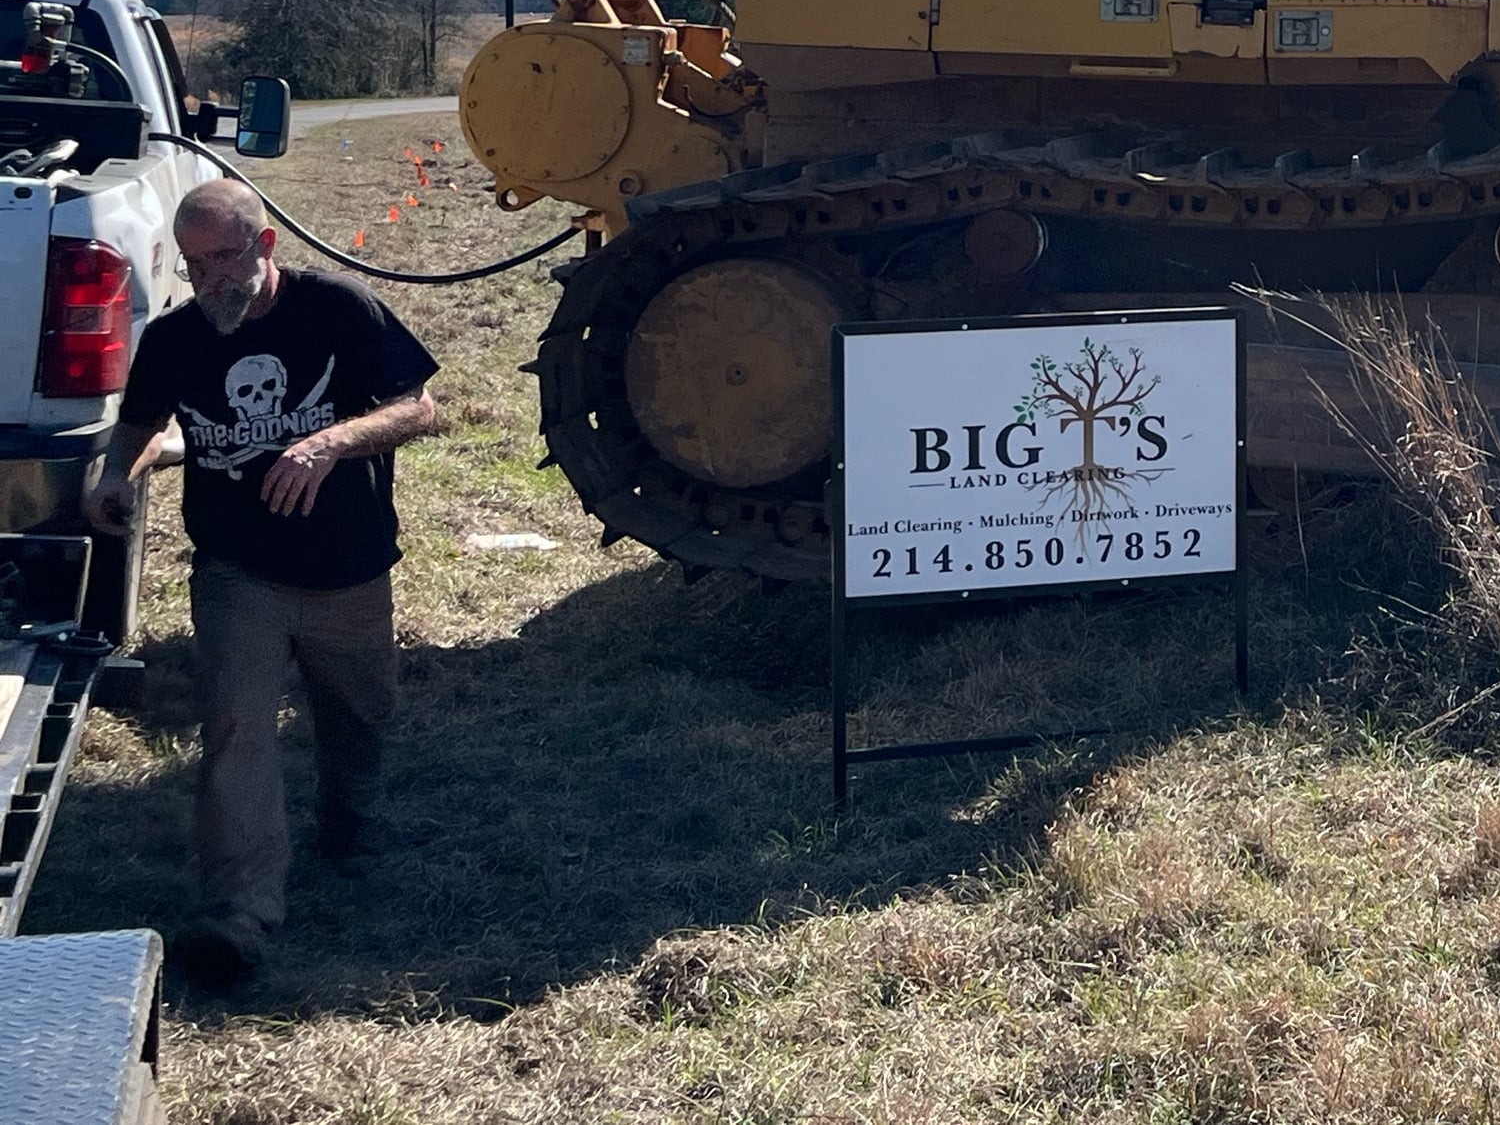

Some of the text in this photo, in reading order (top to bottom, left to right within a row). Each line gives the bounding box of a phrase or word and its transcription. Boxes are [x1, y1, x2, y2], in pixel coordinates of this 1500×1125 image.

[909, 422, 1044, 474] BIG
[950, 467, 1126, 489] LAND CLEARING
[848, 503, 1233, 536] Land Clearing Mulching Dirtwork Driveways
[872, 528, 1202, 579] 214.850.7852
